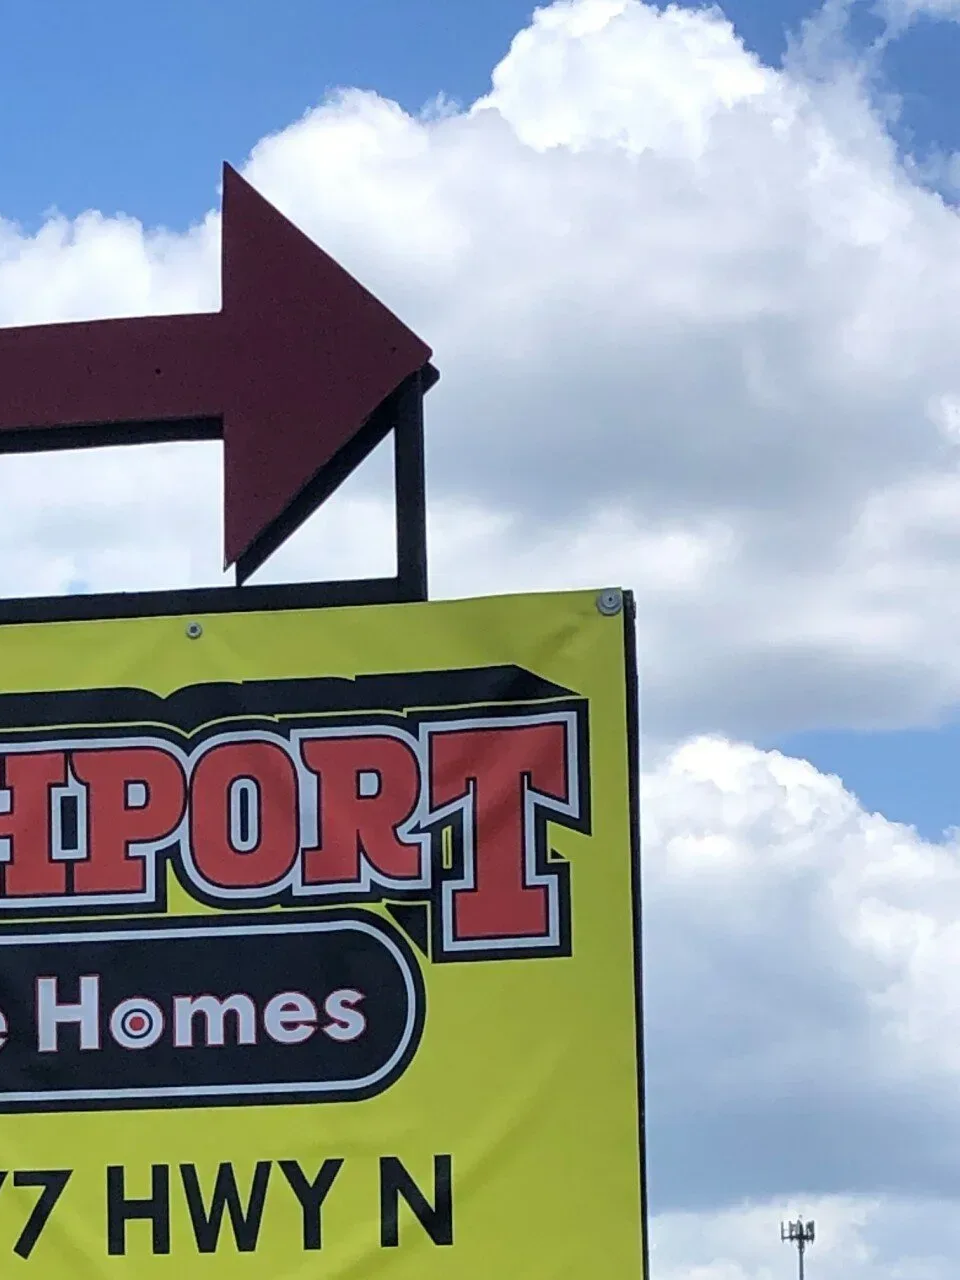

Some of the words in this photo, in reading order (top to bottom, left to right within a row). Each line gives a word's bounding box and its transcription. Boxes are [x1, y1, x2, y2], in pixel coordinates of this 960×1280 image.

[35, 975, 367, 1052] Homes
[106, 1157, 345, 1256] HWY
[379, 1154, 454, 1248] N
